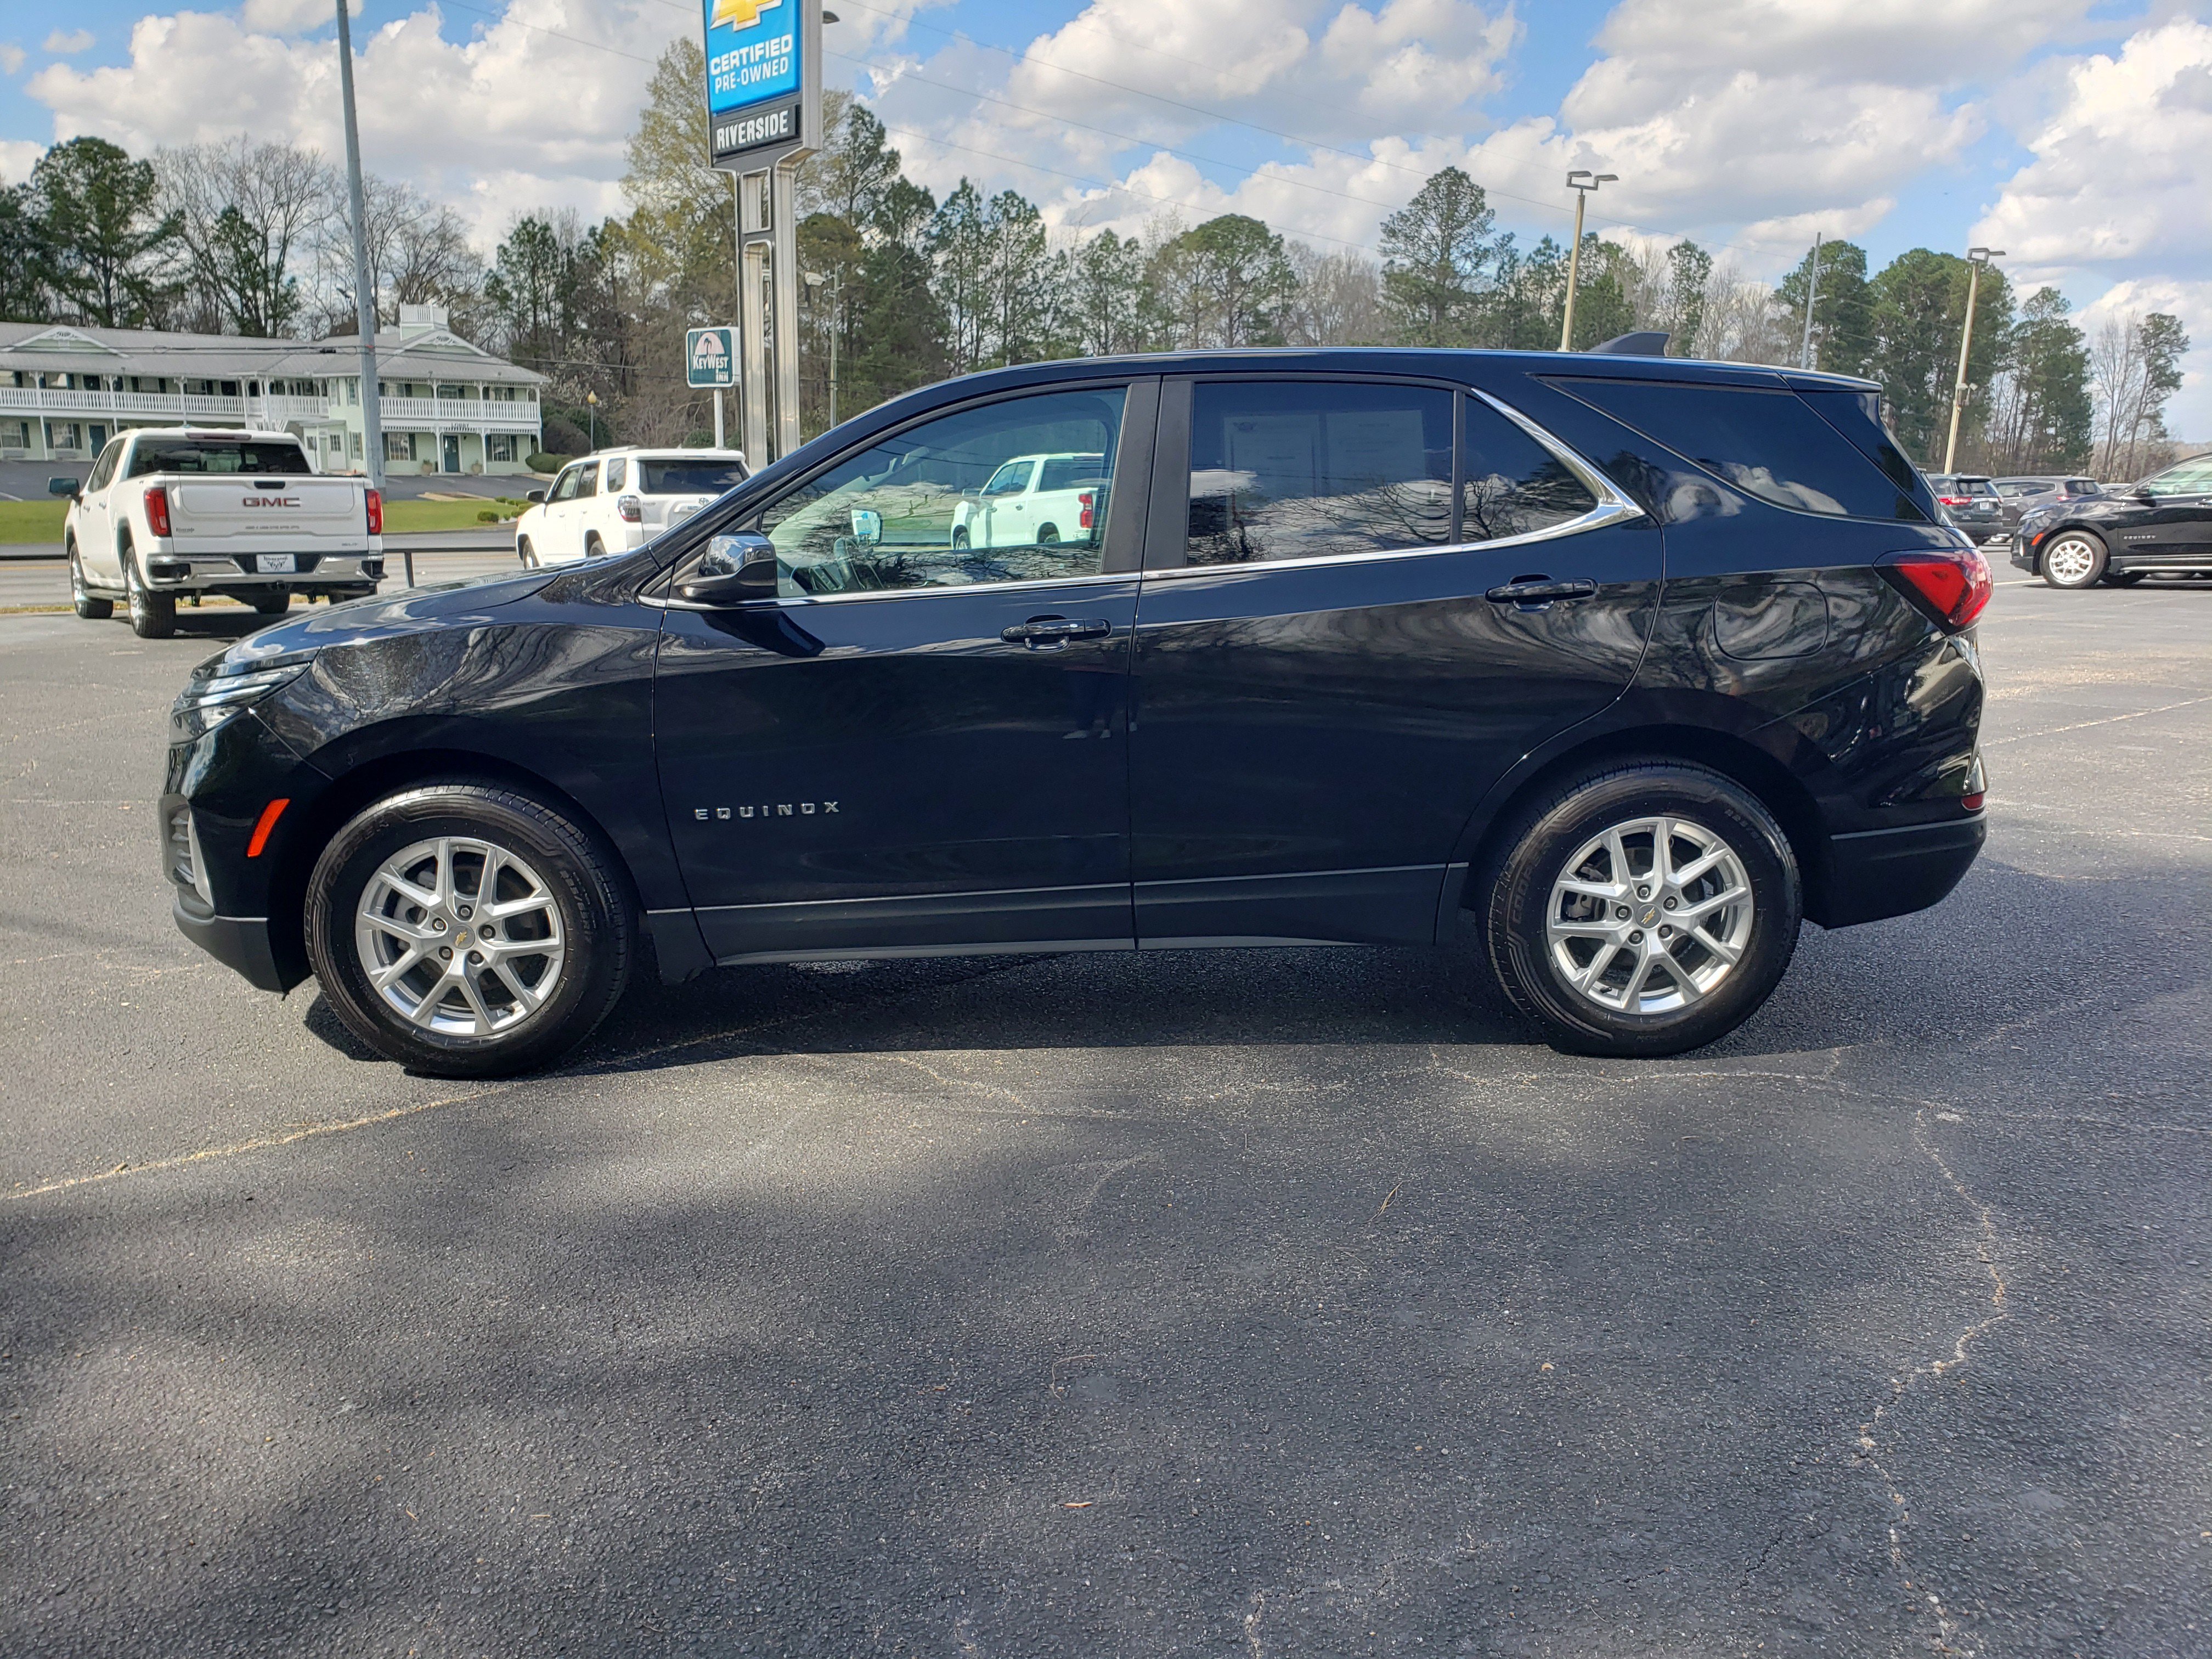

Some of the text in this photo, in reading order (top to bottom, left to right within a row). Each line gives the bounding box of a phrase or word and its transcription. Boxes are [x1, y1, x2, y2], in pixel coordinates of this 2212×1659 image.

[711, 33, 792, 76] CERTIFIED
[715, 57, 788, 94] PRE-OWNED
[716, 110, 788, 150] RIVERSIDE
[243, 497, 301, 507] GMC
[694, 801, 839, 820] EQUINOX
